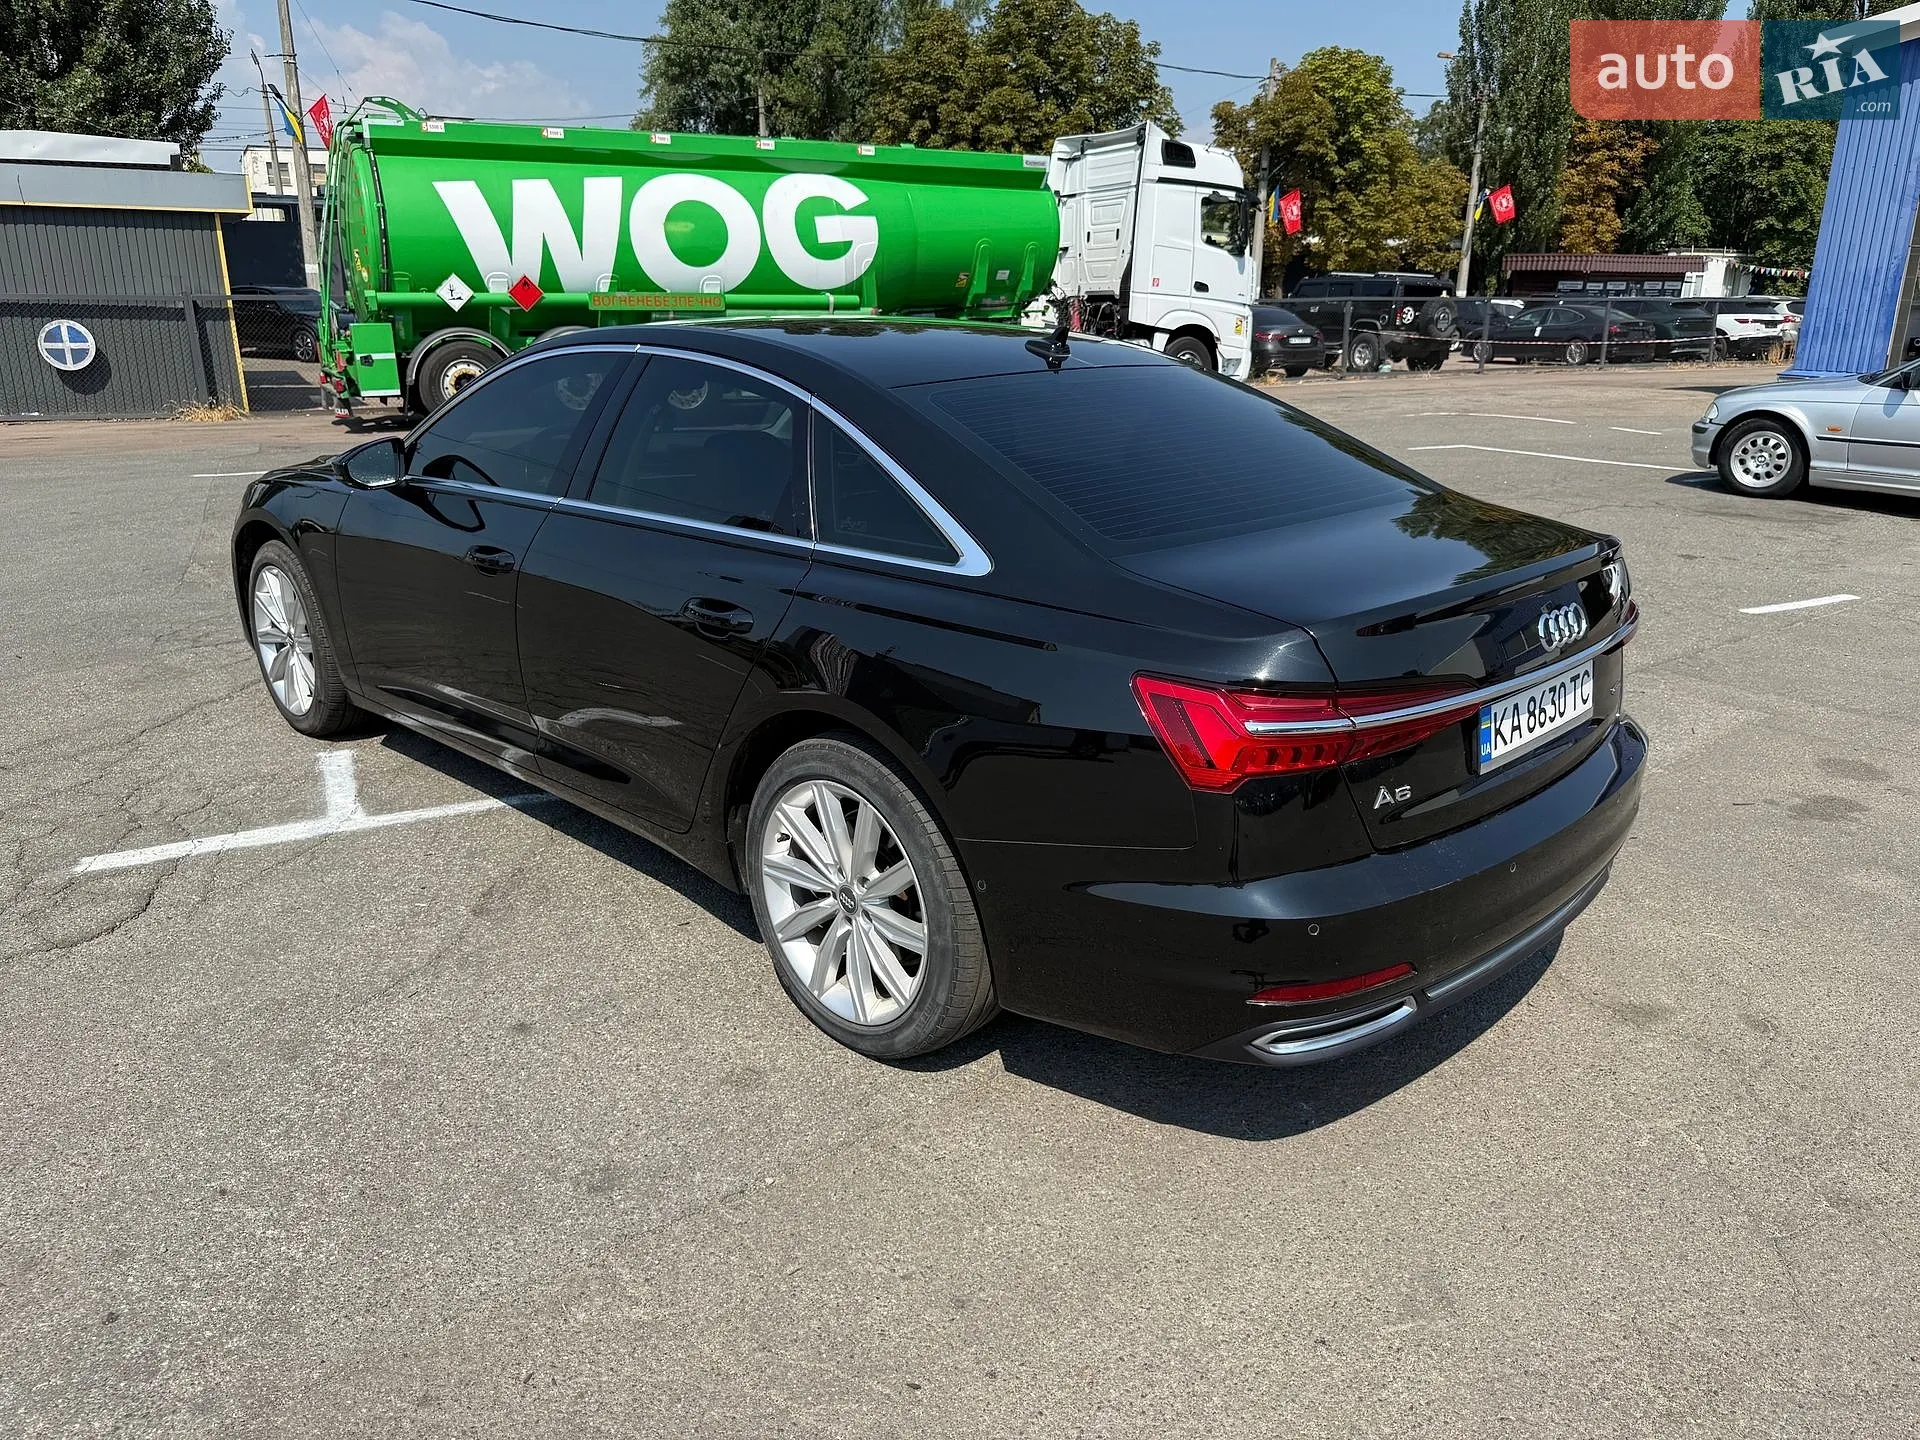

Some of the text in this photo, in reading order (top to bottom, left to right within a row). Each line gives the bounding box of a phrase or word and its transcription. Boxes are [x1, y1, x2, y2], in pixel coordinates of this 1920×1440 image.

[432, 173, 879, 294] WOG
[592, 294, 722, 308] ВОГНЕНЕБЕЗПЕЧНО
[1493, 669, 1590, 751] KA 8630 TC
[1481, 743, 1491, 756] UA
[1373, 785, 1412, 809] A6
